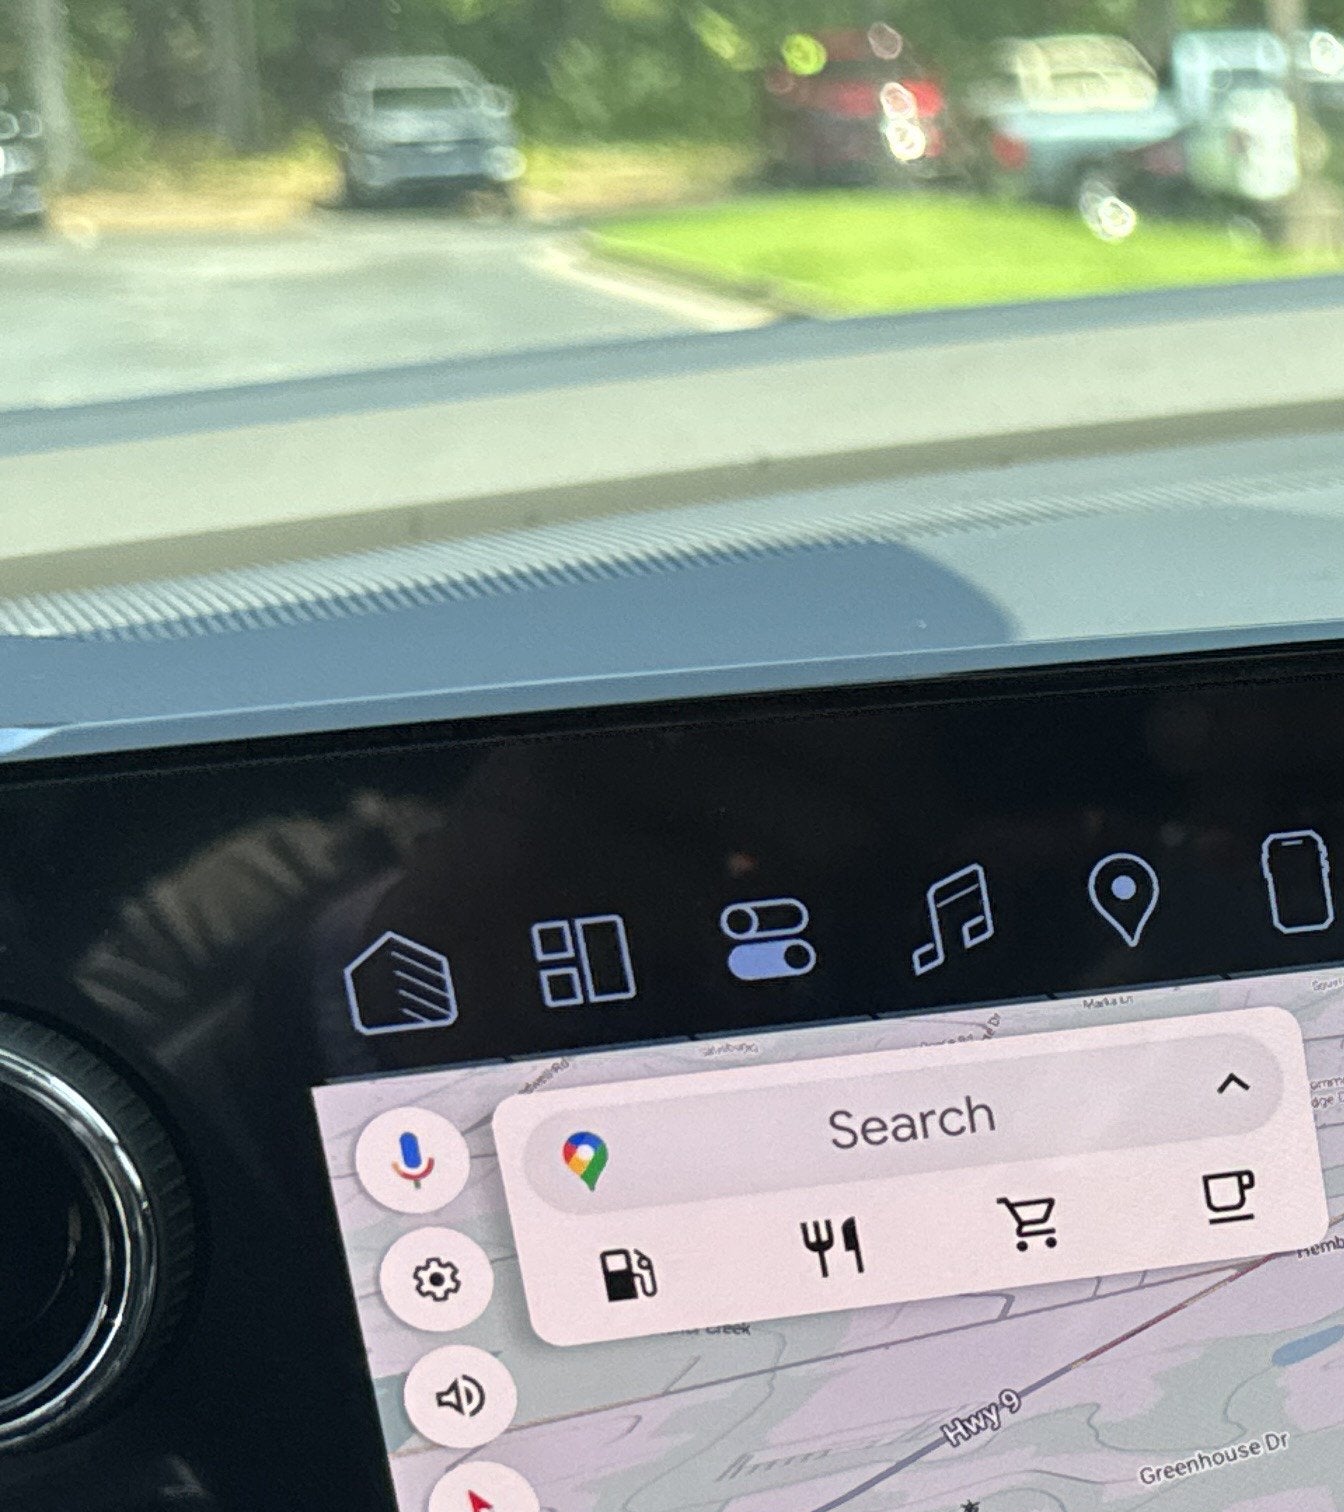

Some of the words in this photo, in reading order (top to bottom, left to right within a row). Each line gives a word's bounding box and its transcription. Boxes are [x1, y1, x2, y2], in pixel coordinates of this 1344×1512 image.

[828, 1095, 997, 1151] Search
[939, 1401, 1001, 1448] Hwy
[1001, 1387, 1022, 1414] 9
[1138, 1438, 1264, 1486] Greenhouse
[1264, 1430, 1291, 1452] Dr
